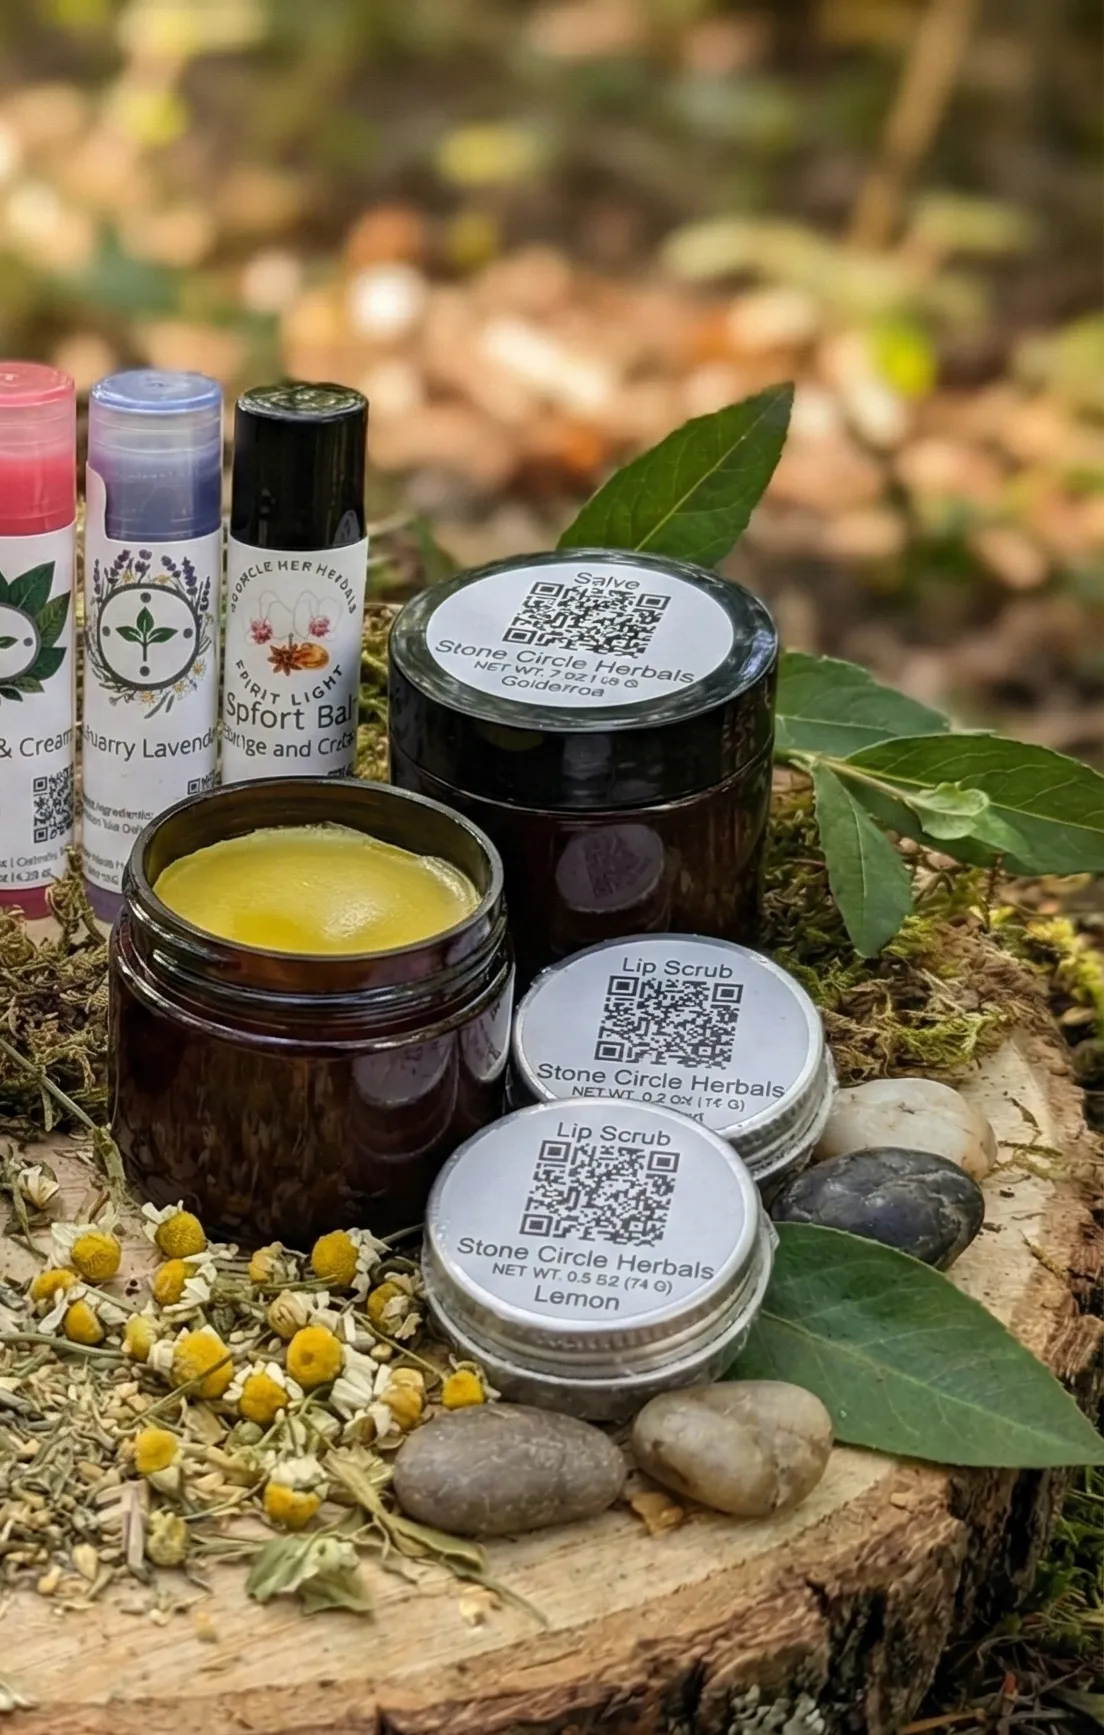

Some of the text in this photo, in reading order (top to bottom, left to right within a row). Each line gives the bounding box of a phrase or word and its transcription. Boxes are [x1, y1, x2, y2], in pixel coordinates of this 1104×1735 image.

[277, 560, 313, 572] HER
[574, 572, 640, 590] Salve
[435, 639, 695, 684] Stone Circle Herbals
[474, 661, 511, 672] NET
[291, 664, 343, 706] LIGHT
[226, 692, 305, 730] Spfort
[273, 739, 311, 757] and
[622, 957, 733, 979] Lip Scrub
[537, 1063, 785, 1098] Stone Circle Herbals
[572, 1086, 605, 1097] NET
[557, 1122, 671, 1146] Lip Scrub
[457, 1237, 715, 1280] Stone Circle Herbals
[492, 1262, 527, 1277] NET
[533, 1266, 563, 1281] WT.
[567, 1271, 591, 1284] 0.5
[535, 1285, 620, 1311] Lemon
